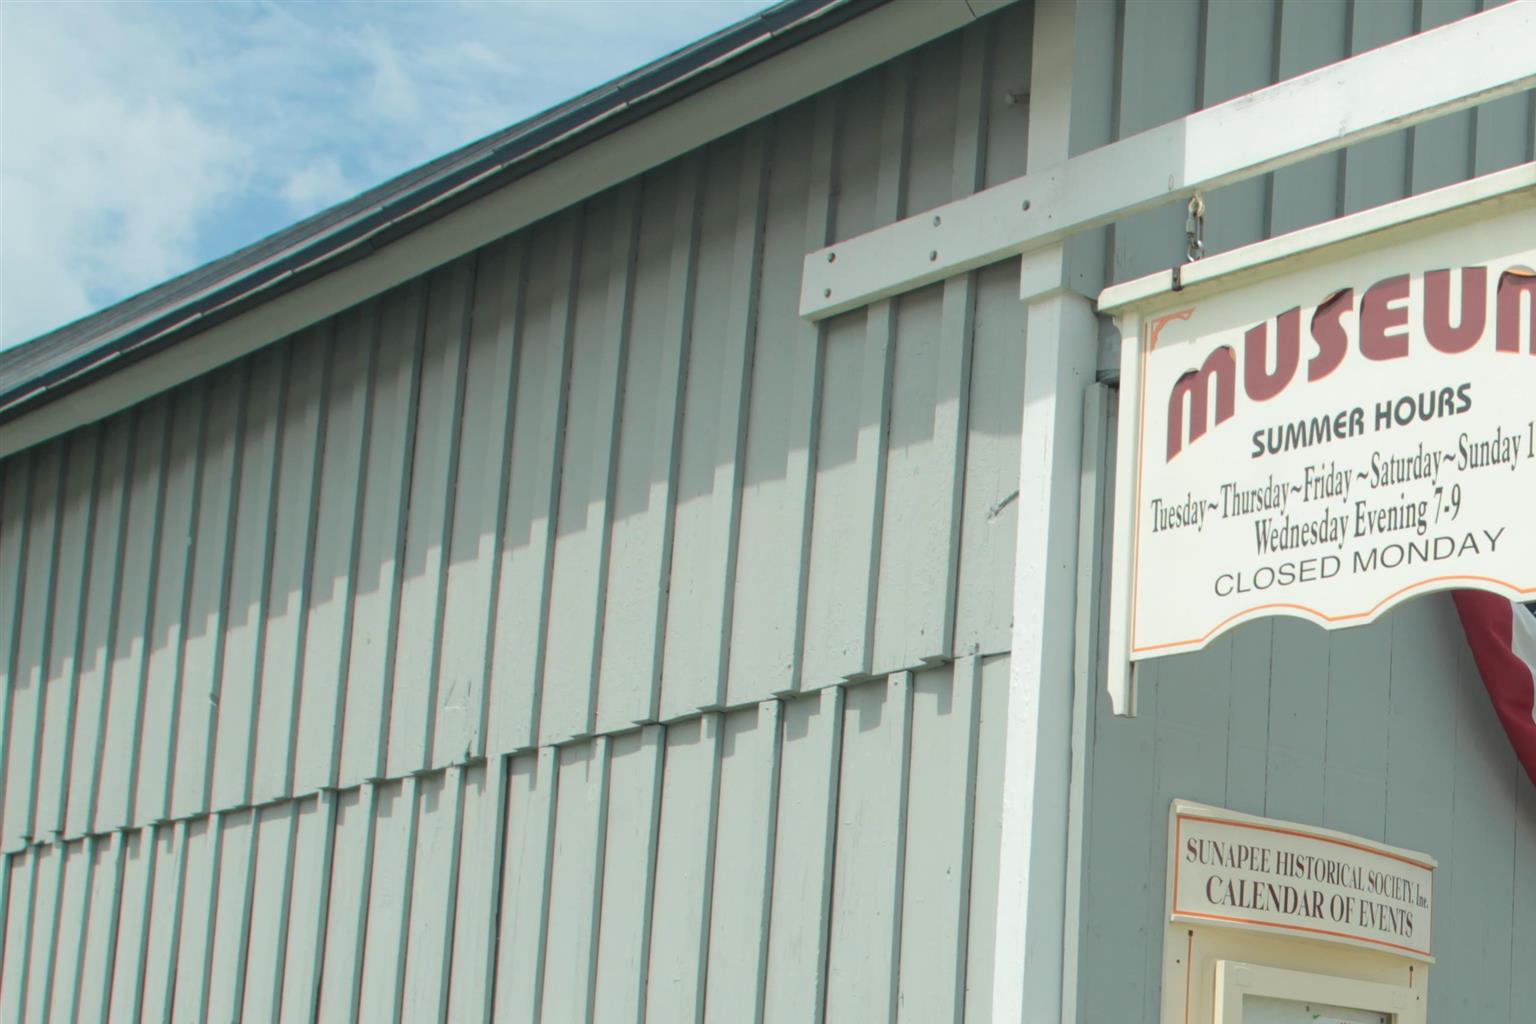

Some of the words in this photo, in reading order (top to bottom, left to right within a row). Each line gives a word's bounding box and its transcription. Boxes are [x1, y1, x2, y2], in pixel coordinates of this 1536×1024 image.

[1251, 407, 1365, 459] SUMMER
[1375, 382, 1473, 432] HOURS
[1255, 507, 1350, 556] Wednesday
[1353, 493, 1428, 536] Evening
[1433, 483, 1461, 525] 7-9
[1214, 555, 1342, 597] CLOSED
[1352, 527, 1506, 573] MONDAY
[1186, 837, 1271, 874] SUNAPEE
[1275, 850, 1365, 892] HISTORICAL
[1416, 883, 1429, 909] Inc.
[1205, 875, 1325, 921] CALENDAR
[1330, 893, 1354, 924] OF
[1359, 900, 1413, 938] EVENTS
